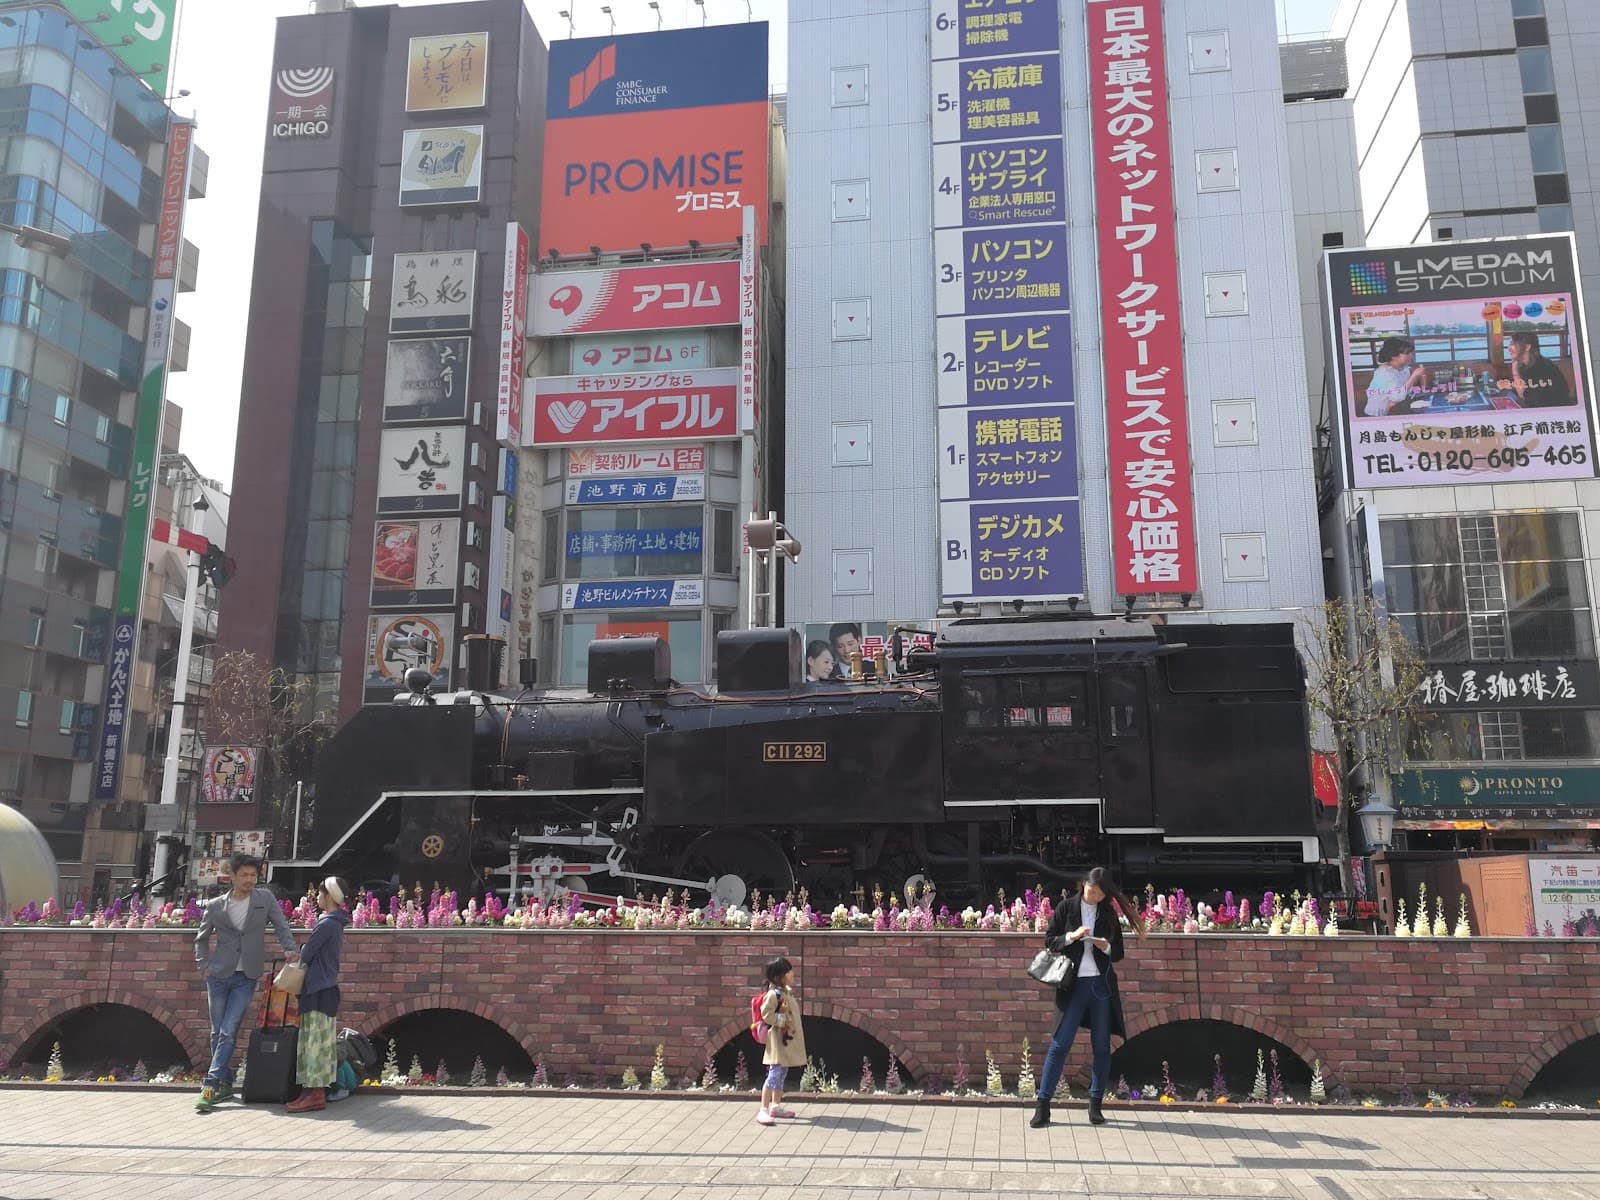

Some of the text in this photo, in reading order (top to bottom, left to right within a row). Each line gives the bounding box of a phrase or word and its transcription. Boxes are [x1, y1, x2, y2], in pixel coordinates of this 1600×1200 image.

[936, 12, 957, 31] 6F
[965, 11, 1023, 29] 調理家電
[965, 29, 1009, 45] 掃除機
[616, 80, 642, 89] SMBC
[967, 64, 1043, 92] 冷蔵庫
[616, 86, 668, 98] CONSUMER
[616, 95, 657, 106] FINANCE
[276, 104, 328, 119] 一期一会
[937, 93, 958, 112] 5F
[968, 97, 1010, 114] 洗濯機
[272, 120, 328, 137] ICHIGO
[968, 111, 1040, 130] 理美容器具
[968, 148, 1047, 171] パソコン
[565, 150, 744, 197] PROMISE
[968, 168, 1047, 192] サプライ
[938, 177, 960, 196] 4F
[676, 191, 743, 213] プロミス
[968, 191, 1056, 209] 企業法人専用窓口
[978, 209, 1011, 221] Smart
[971, 239, 1053, 264] パソコン
[940, 264, 962, 283] 3F
[972, 268, 1028, 283] プリンタ
[1395, 268, 1556, 293] STADIUM
[632, 281, 721, 312] アコム
[744, 284, 753, 317] アイフル
[972, 285, 1061, 301] パソコン周辺機器
[1103, 6, 1181, 583] 日本最大のネットワークサービスで安心価格
[503, 299, 513, 331] アイフル
[973, 325, 1051, 353] テレビ
[611, 346, 700, 366] アコム 6F
[943, 352, 965, 373] 2F
[744, 328, 753, 407] 新規会員募集中
[975, 359, 1041, 375] レコーダー
[499, 341, 511, 417] 新規会員募集中
[577, 374, 694, 391] キャッシングなら
[591, 394, 724, 433] アイフル
[976, 416, 1062, 445] 携帯電話
[1359, 424, 1495, 445] 月島もんじゃ屋形船
[595, 452, 672, 471] 契約ルーム
[677, 449, 703, 463] 2台
[946, 445, 966, 465] 1F
[976, 450, 1062, 467] スマートフォン
[570, 463, 587, 474] 5F
[132, 462, 150, 508] レイク
[976, 470, 1051, 487] アクセサリー
[587, 482, 668, 498] 池野商店
[978, 513, 1065, 541] デジカメ
[947, 540, 968, 561] B1
[979, 547, 1049, 562] オーディオ
[581, 587, 668, 603] 池野ビルメンテナンス
[101, 648, 130, 788] かんべ土地 新橋支店
[1485, 777, 1563, 789] PRONTO
[1551, 864, 1600, 877] 汽笛一
